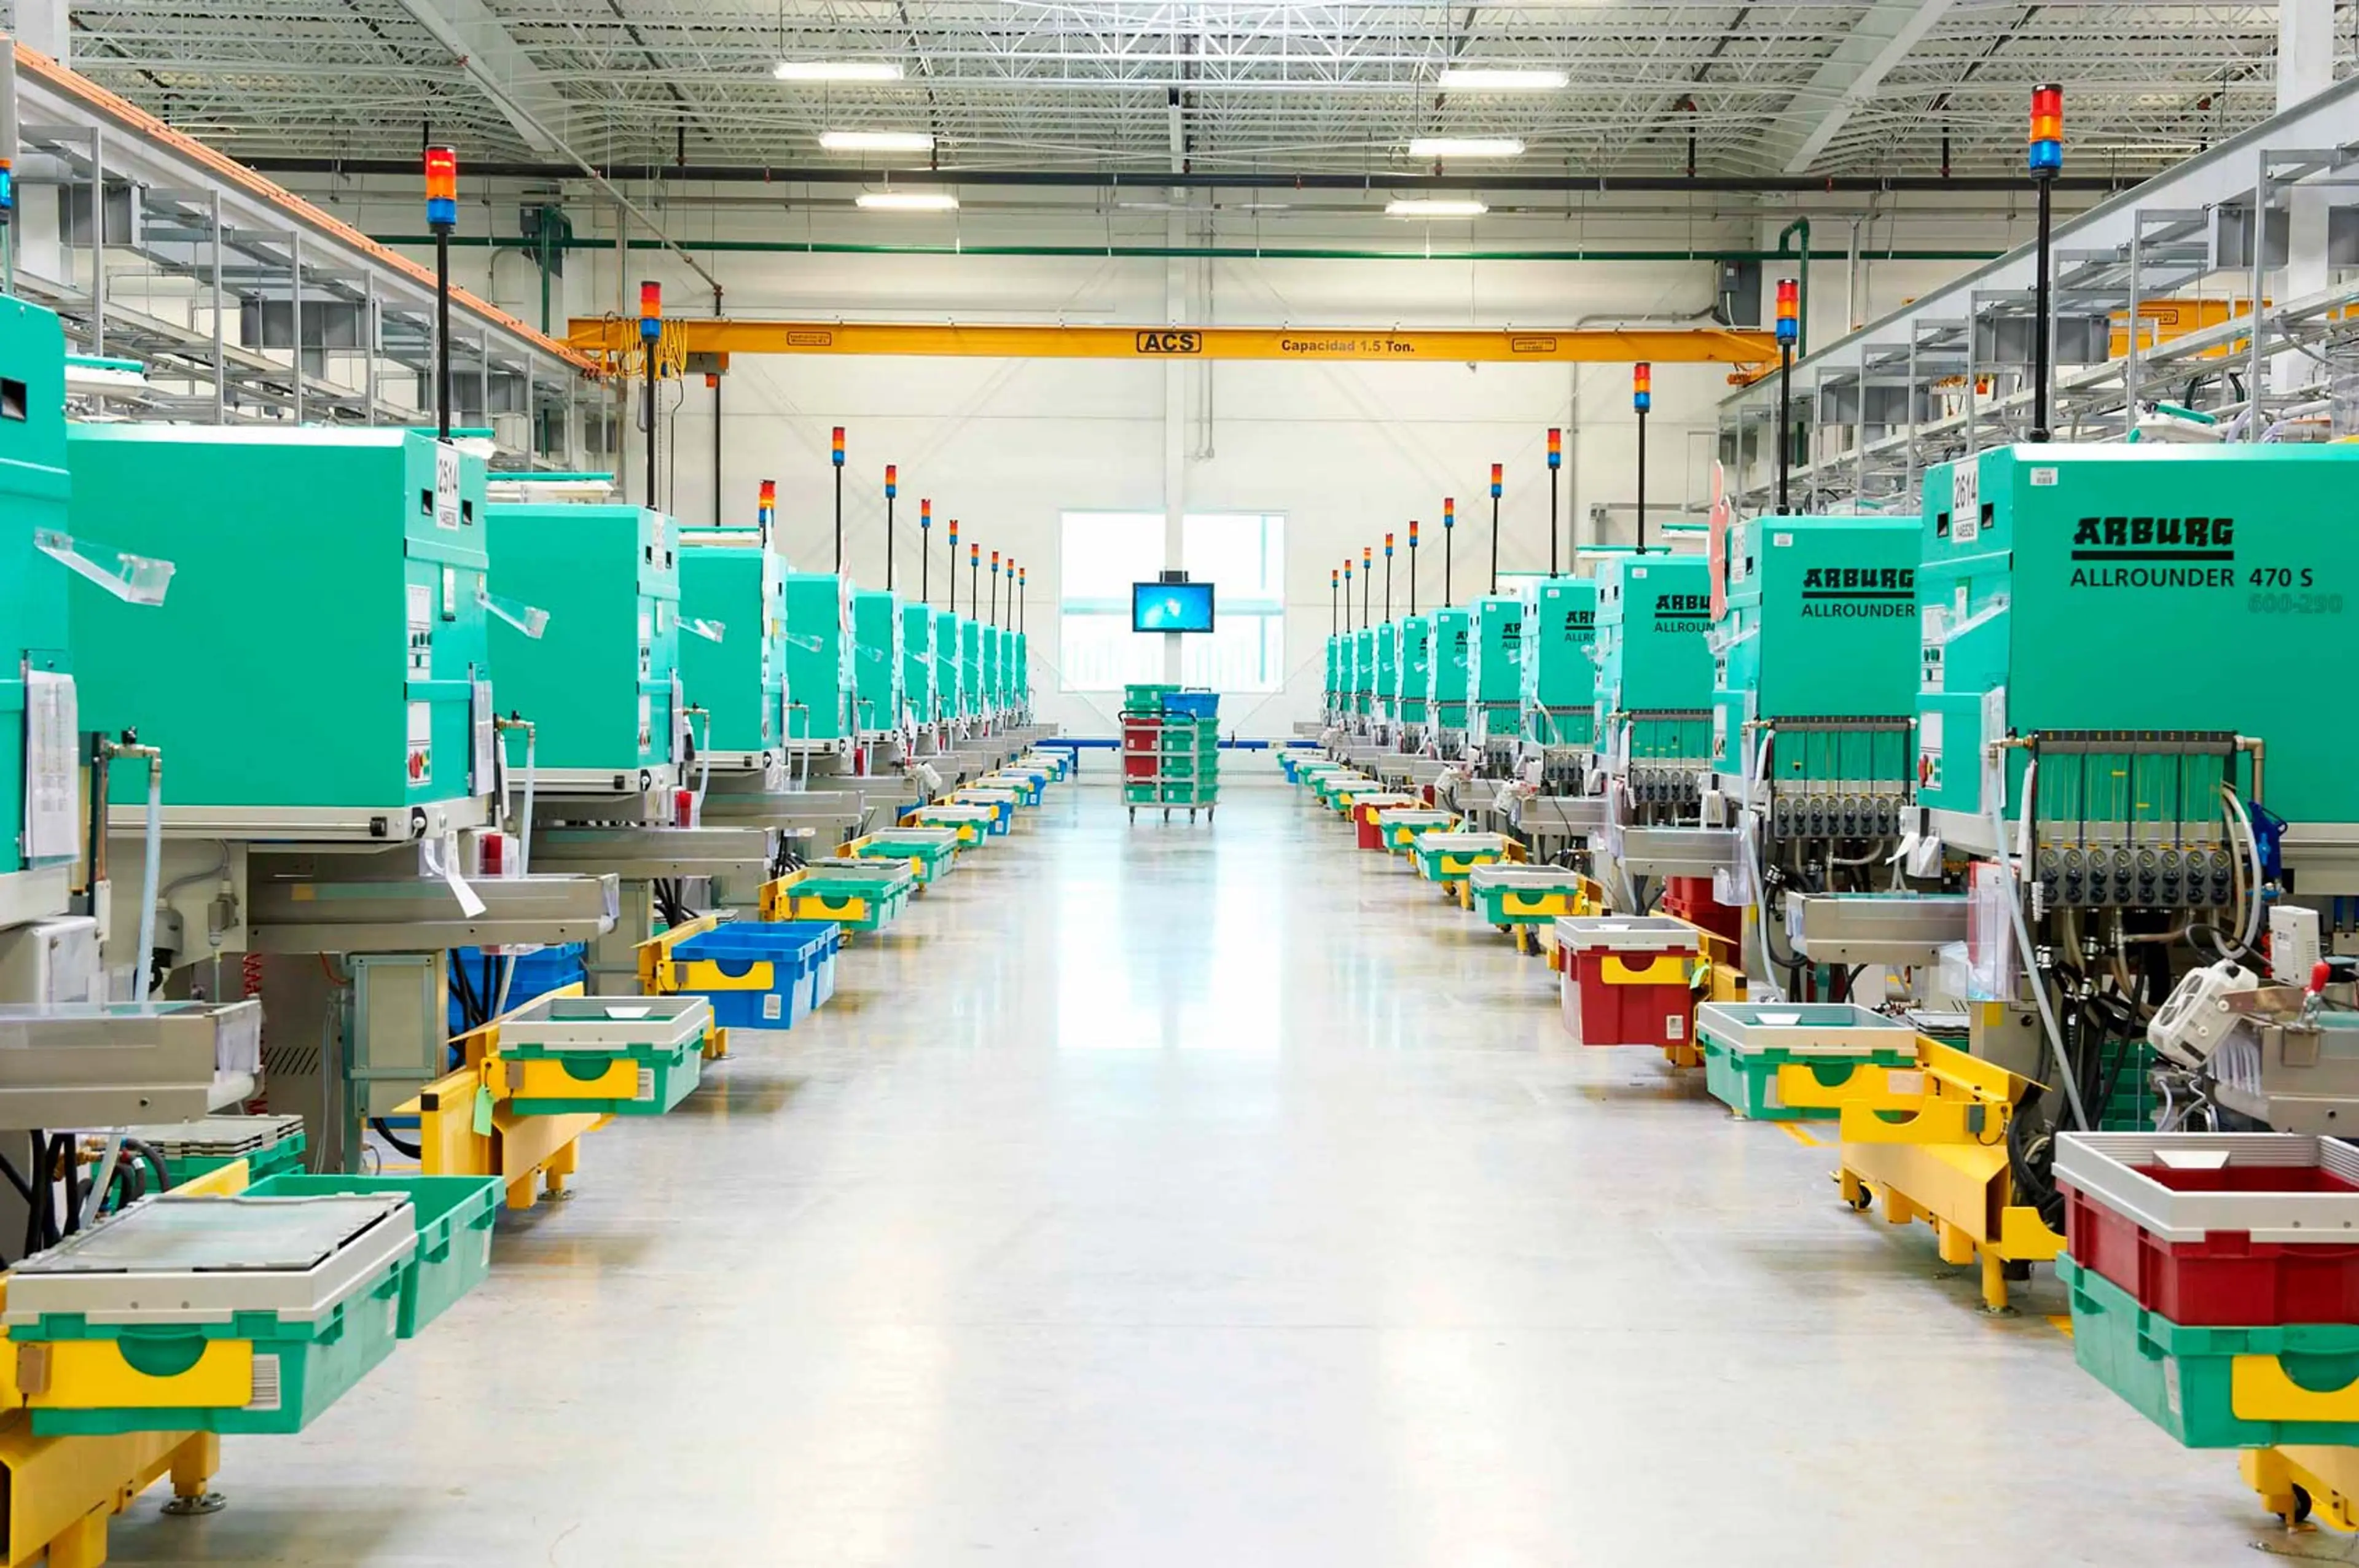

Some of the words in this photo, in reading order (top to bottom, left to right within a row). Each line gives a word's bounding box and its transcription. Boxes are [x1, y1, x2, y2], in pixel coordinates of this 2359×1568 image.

[1144, 333, 1194, 351] ACS
[1281, 340, 1355, 353] Capacidad
[1360, 340, 1381, 352] 1.5
[1386, 340, 1415, 352] Ton.
[1955, 471, 1976, 509] 2614
[2074, 517, 2234, 547] ARBURG
[1802, 568, 1915, 588] ARBURG
[2070, 568, 2234, 587] ALLROUNDER
[2248, 568, 2292, 587] 470
[2300, 568, 2314, 587] S
[1656, 595, 1710, 609] ARBU
[1801, 603, 1916, 617] ALLROUNDER
